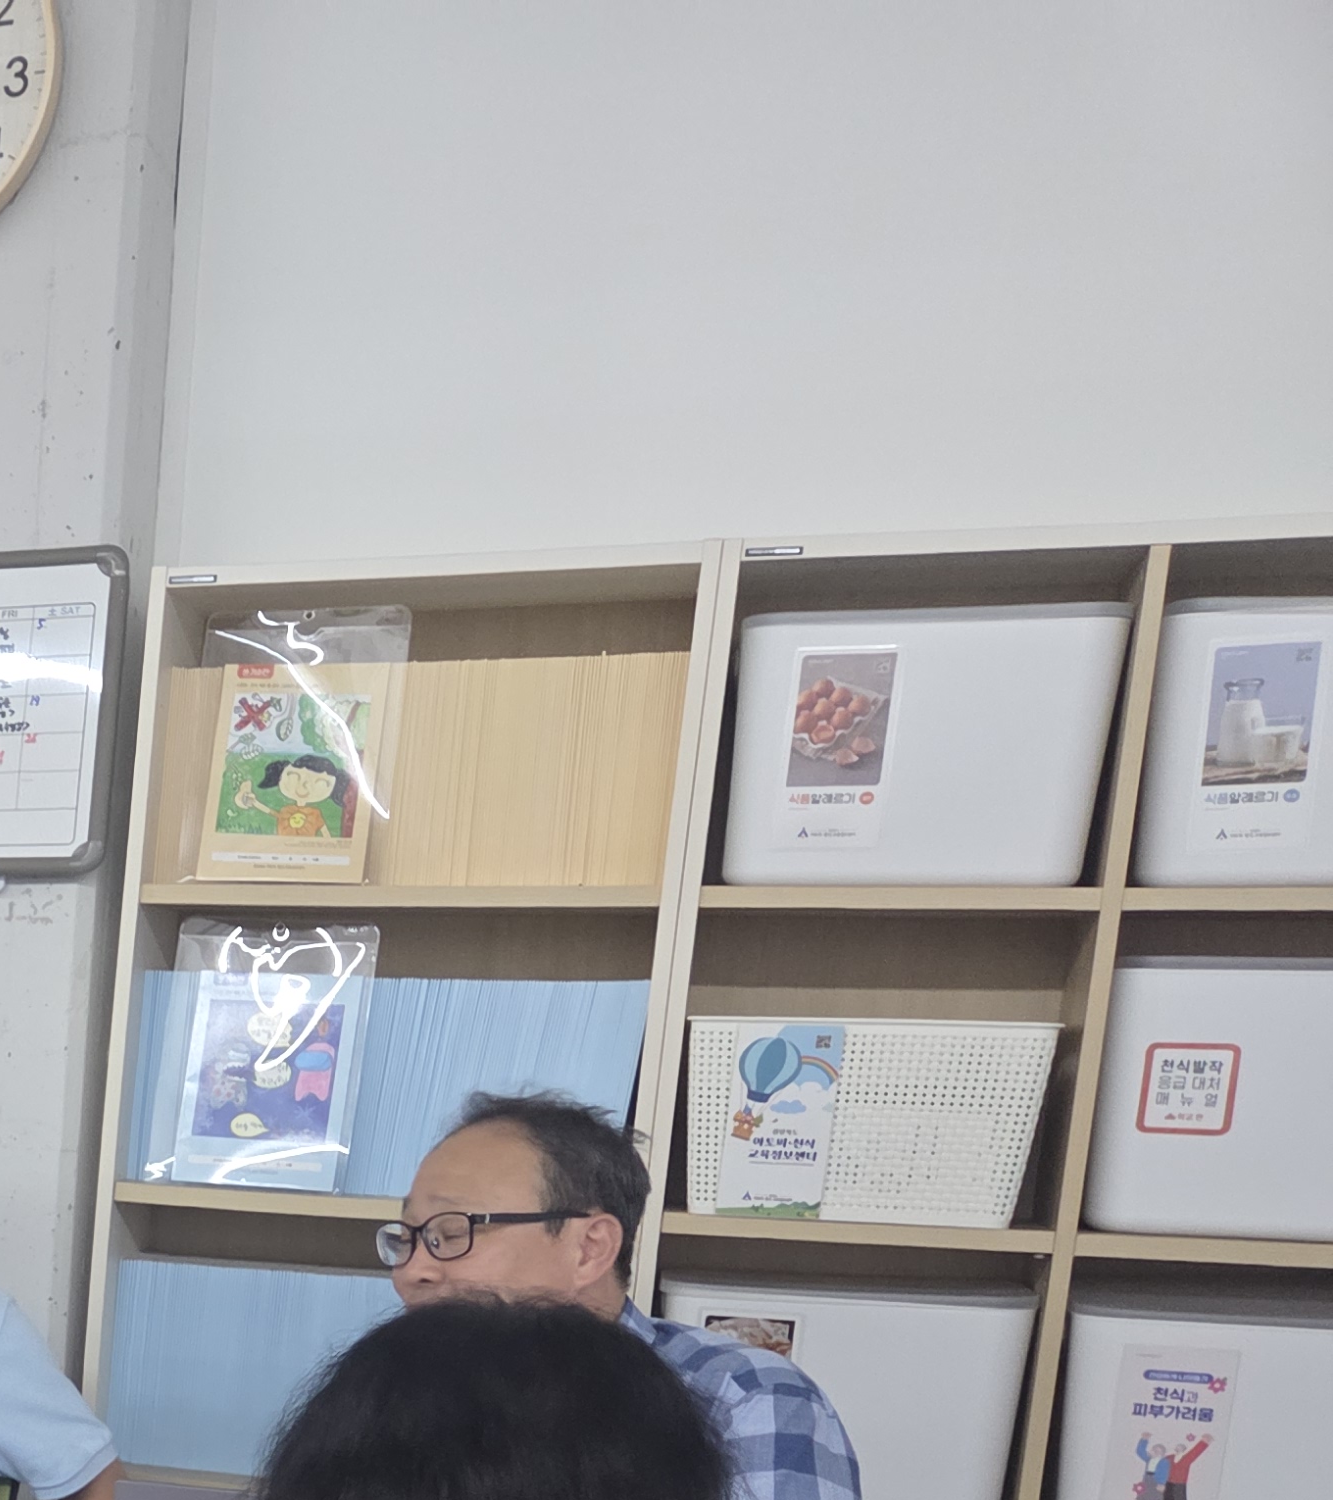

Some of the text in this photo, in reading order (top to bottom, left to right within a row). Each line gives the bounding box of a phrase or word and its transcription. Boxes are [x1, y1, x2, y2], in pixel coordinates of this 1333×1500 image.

[3, 56, 29, 98] 3
[1, 609, 19, 618] FRI
[60, 606, 81, 616] SAT
[36, 618, 46, 629] 5
[788, 792, 856, 805] 식품알레르기
[1203, 790, 1279, 805] 식품알레르기
[1160, 1058, 1224, 1075] 천식발작
[1157, 1075, 1221, 1091] 응급 대처
[1155, 1091, 1219, 1108] 매 뉴 얼
[747, 1150, 818, 1162] 교육정보센터
[1152, 1386, 1199, 1404] 천식과
[1131, 1402, 1215, 1423] 피부가려움
